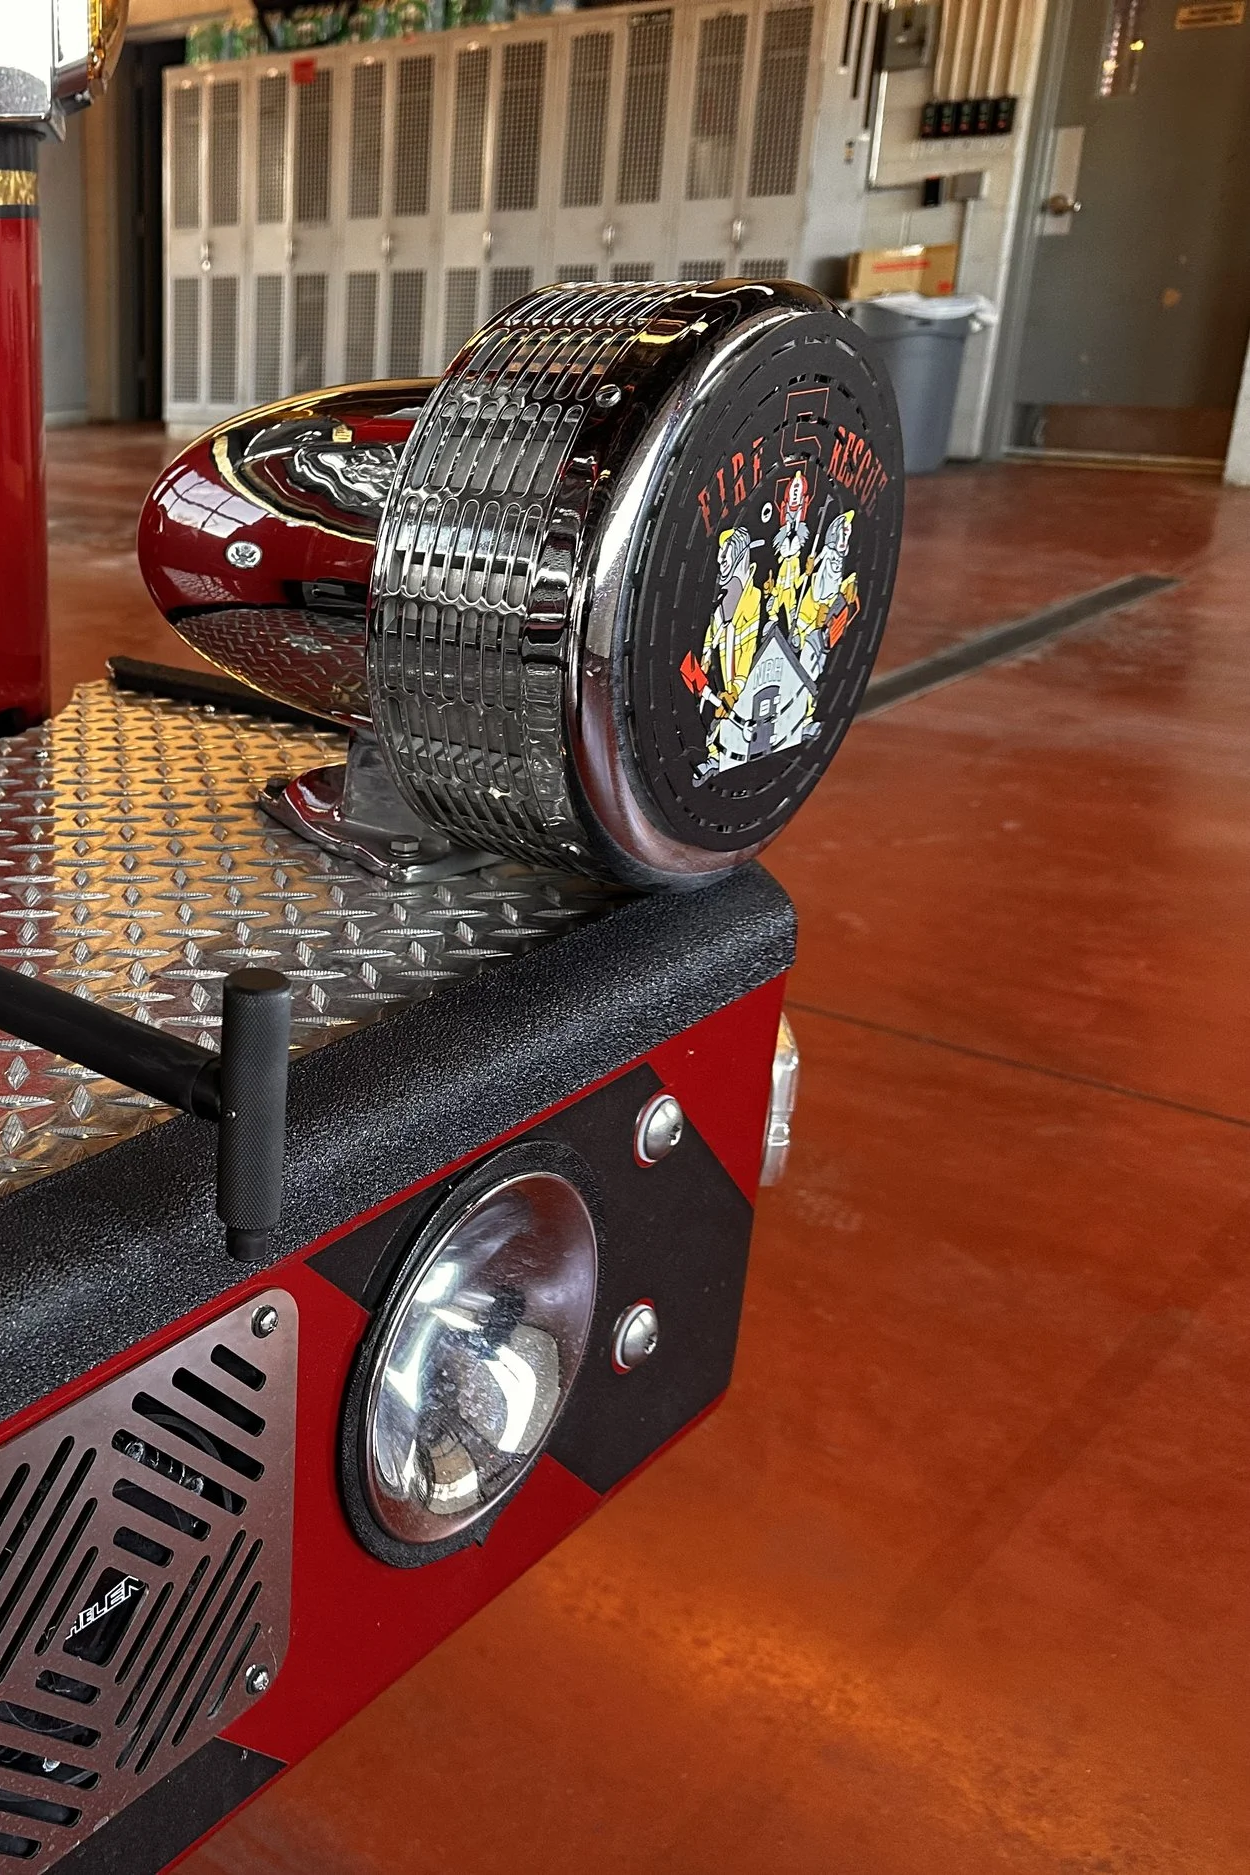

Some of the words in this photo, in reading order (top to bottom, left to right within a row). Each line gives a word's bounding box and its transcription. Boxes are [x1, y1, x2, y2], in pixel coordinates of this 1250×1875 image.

[698, 437, 764, 536] FIRE
[774, 387, 830, 512] 5
[827, 424, 889, 517] RESCUE
[752, 657, 785, 691] NRH
[44, 1574, 141, 1643] HELEN
